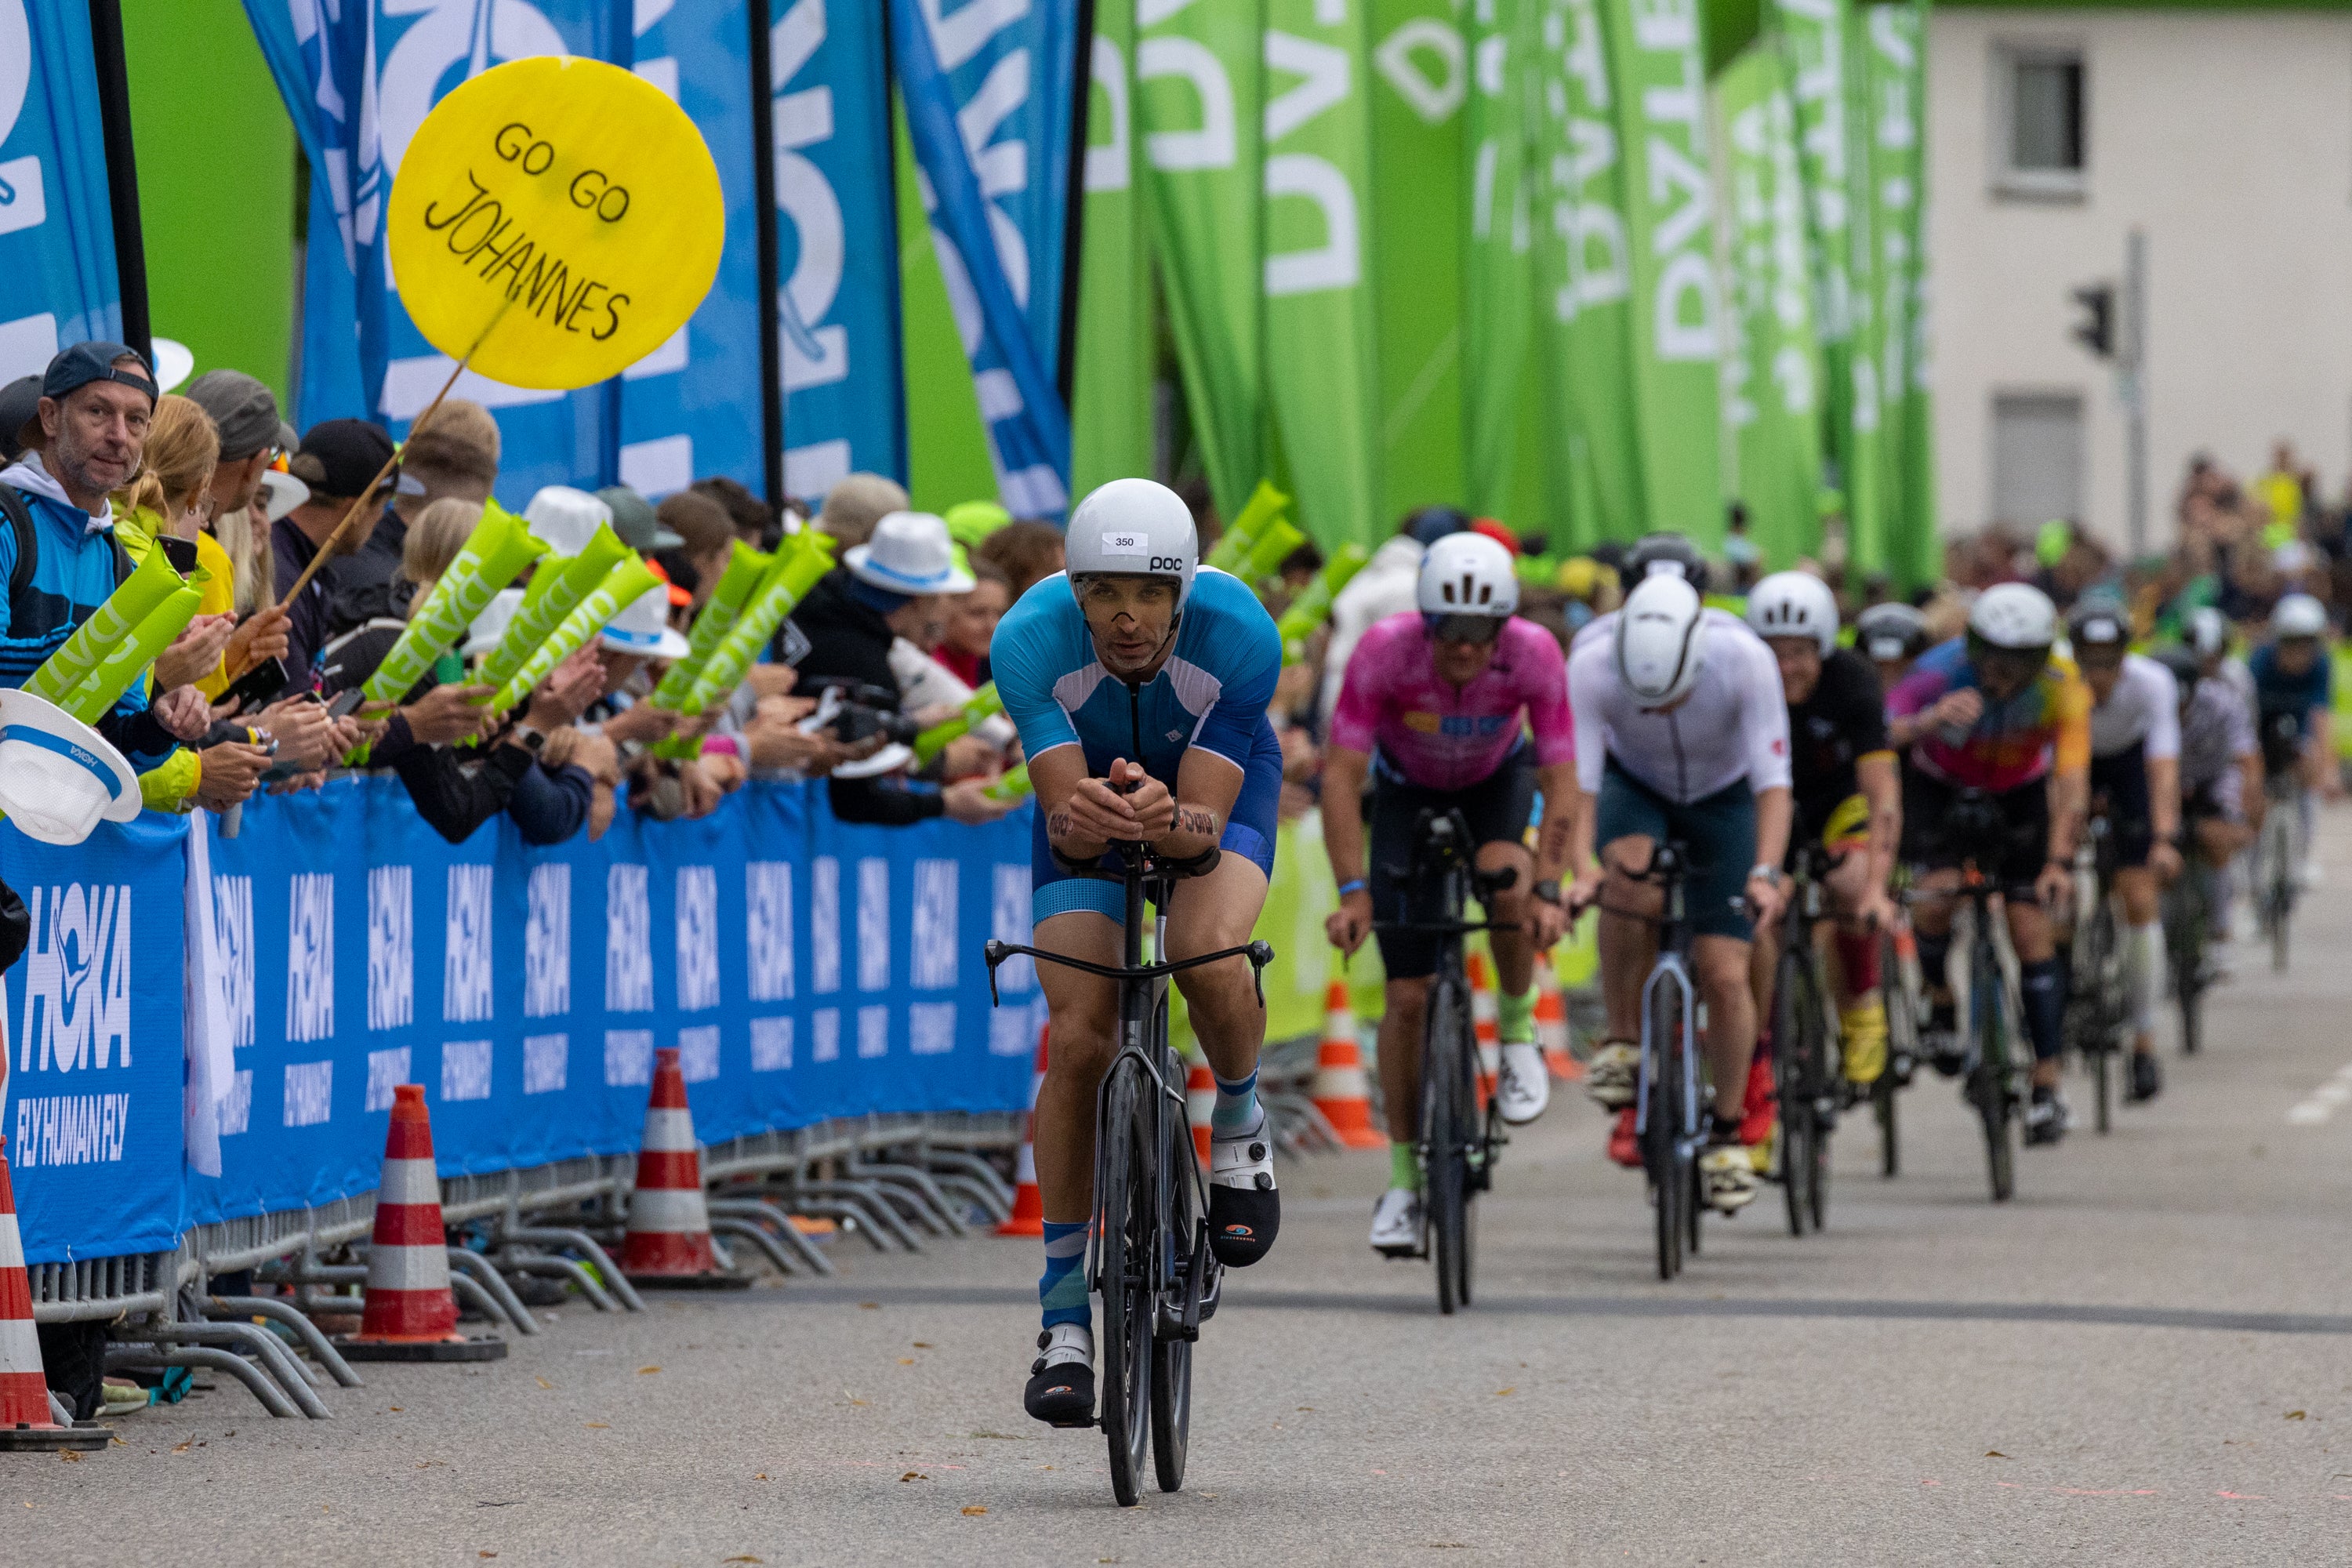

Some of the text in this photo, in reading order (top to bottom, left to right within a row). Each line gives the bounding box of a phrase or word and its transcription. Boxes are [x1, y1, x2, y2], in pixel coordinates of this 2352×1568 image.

[495, 122, 630, 223] GO GO
[424, 168, 630, 341] JOHANNES
[1116, 538, 1134, 546] 350
[70, 745, 98, 768] HOKA
[20, 882, 131, 1073] HOKA
[16, 1098, 42, 1167] FLY
[42, 1095, 103, 1167] HUMAN
[101, 1093, 130, 1162] FLY
